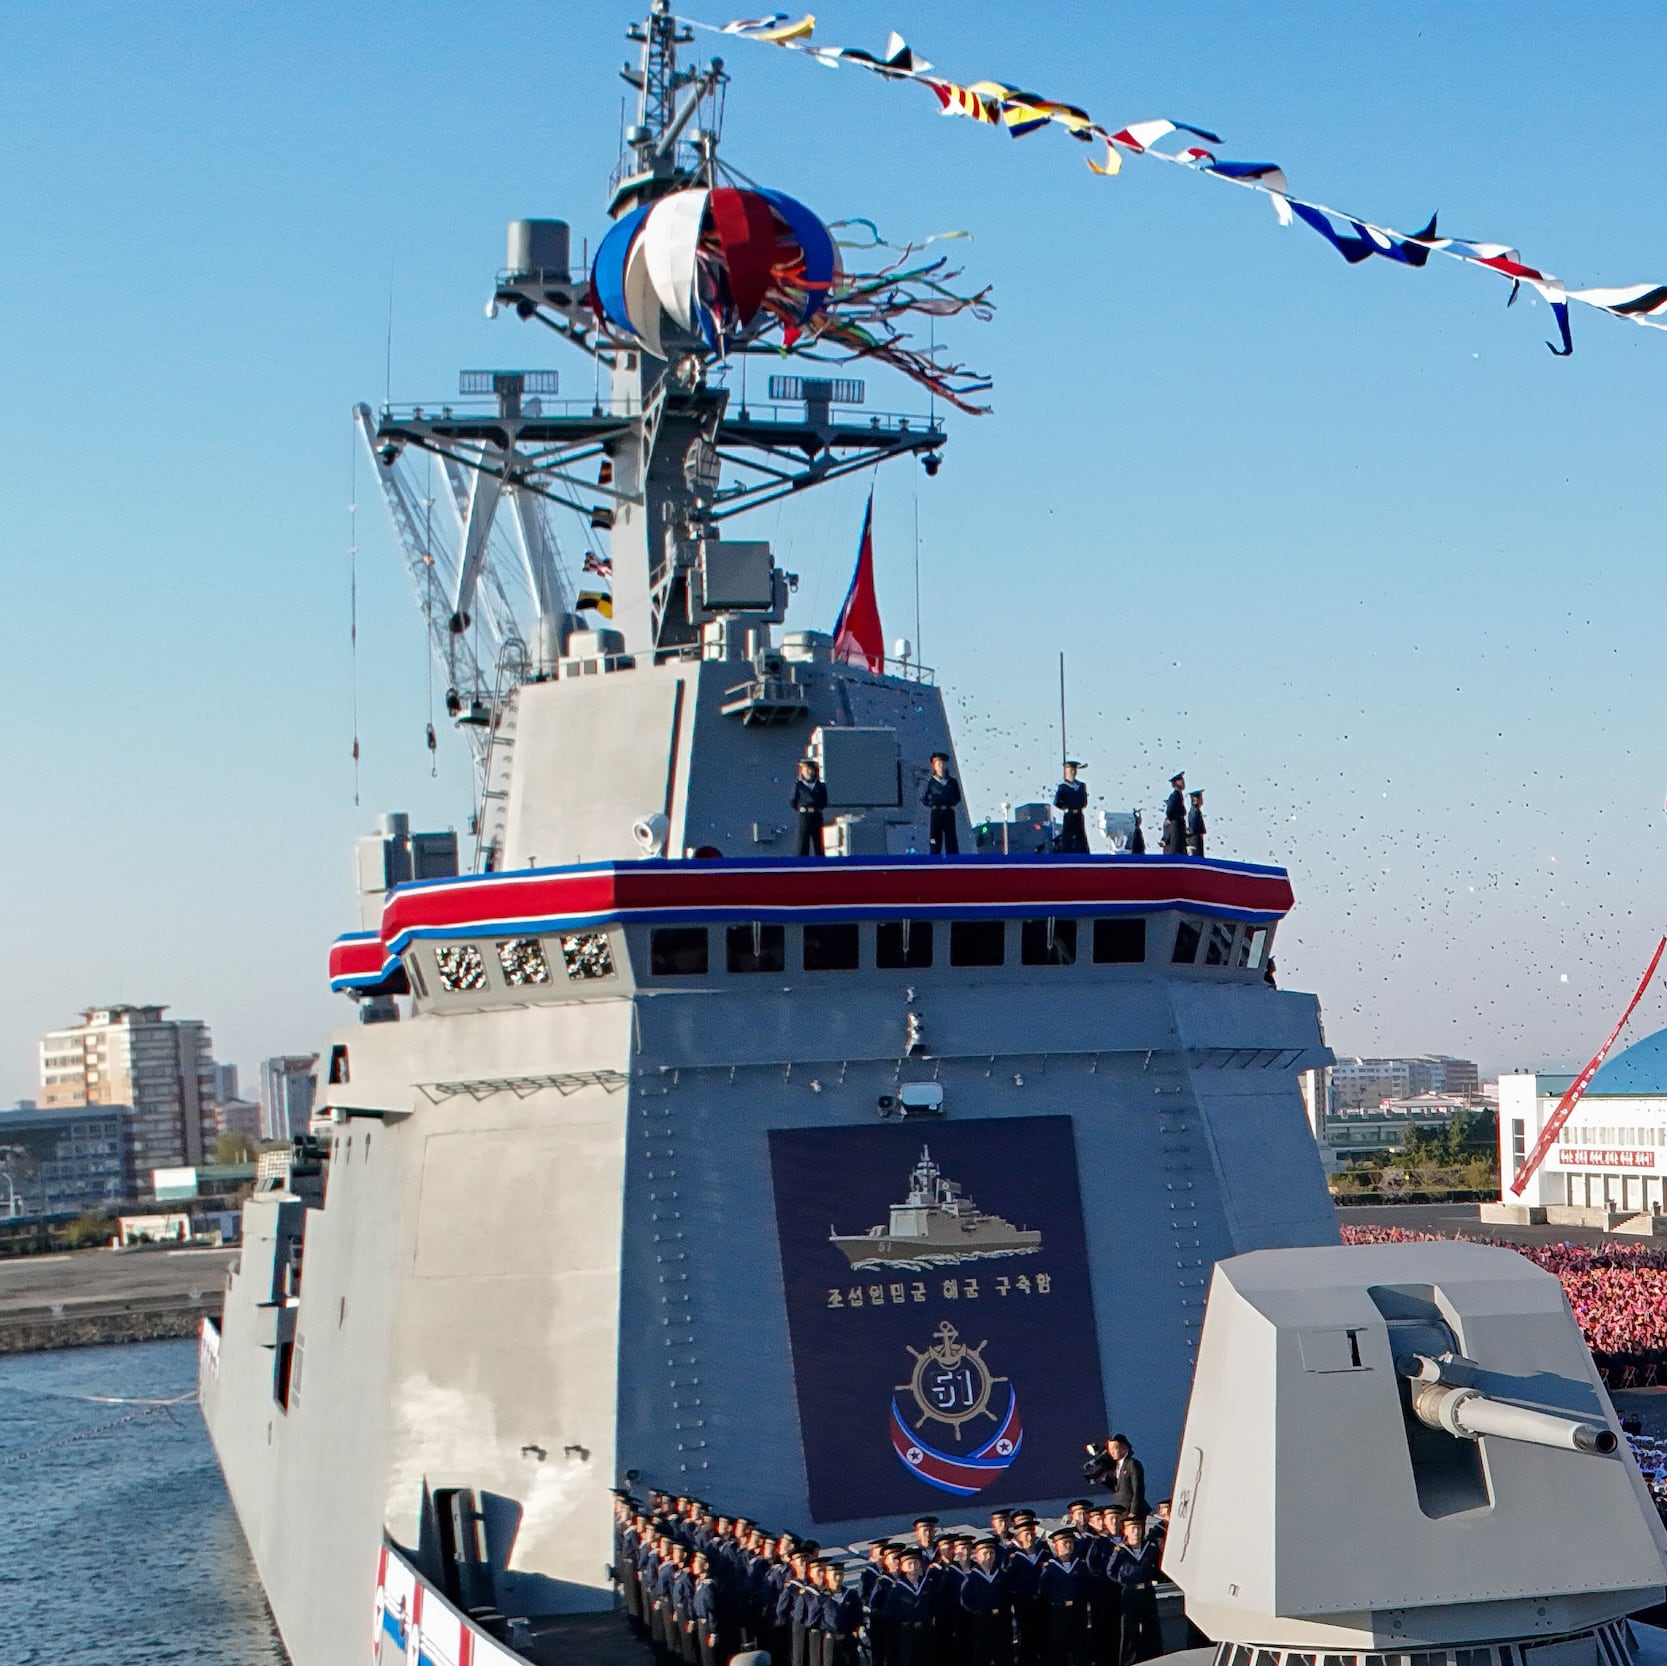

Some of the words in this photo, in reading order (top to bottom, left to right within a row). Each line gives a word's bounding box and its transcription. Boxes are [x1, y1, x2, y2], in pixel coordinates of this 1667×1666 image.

[827, 1281, 927, 1309] 조선인민군
[942, 1278, 980, 1299] 해군
[994, 1272, 1051, 1297] 구축함
[930, 1368, 974, 1408] 51
